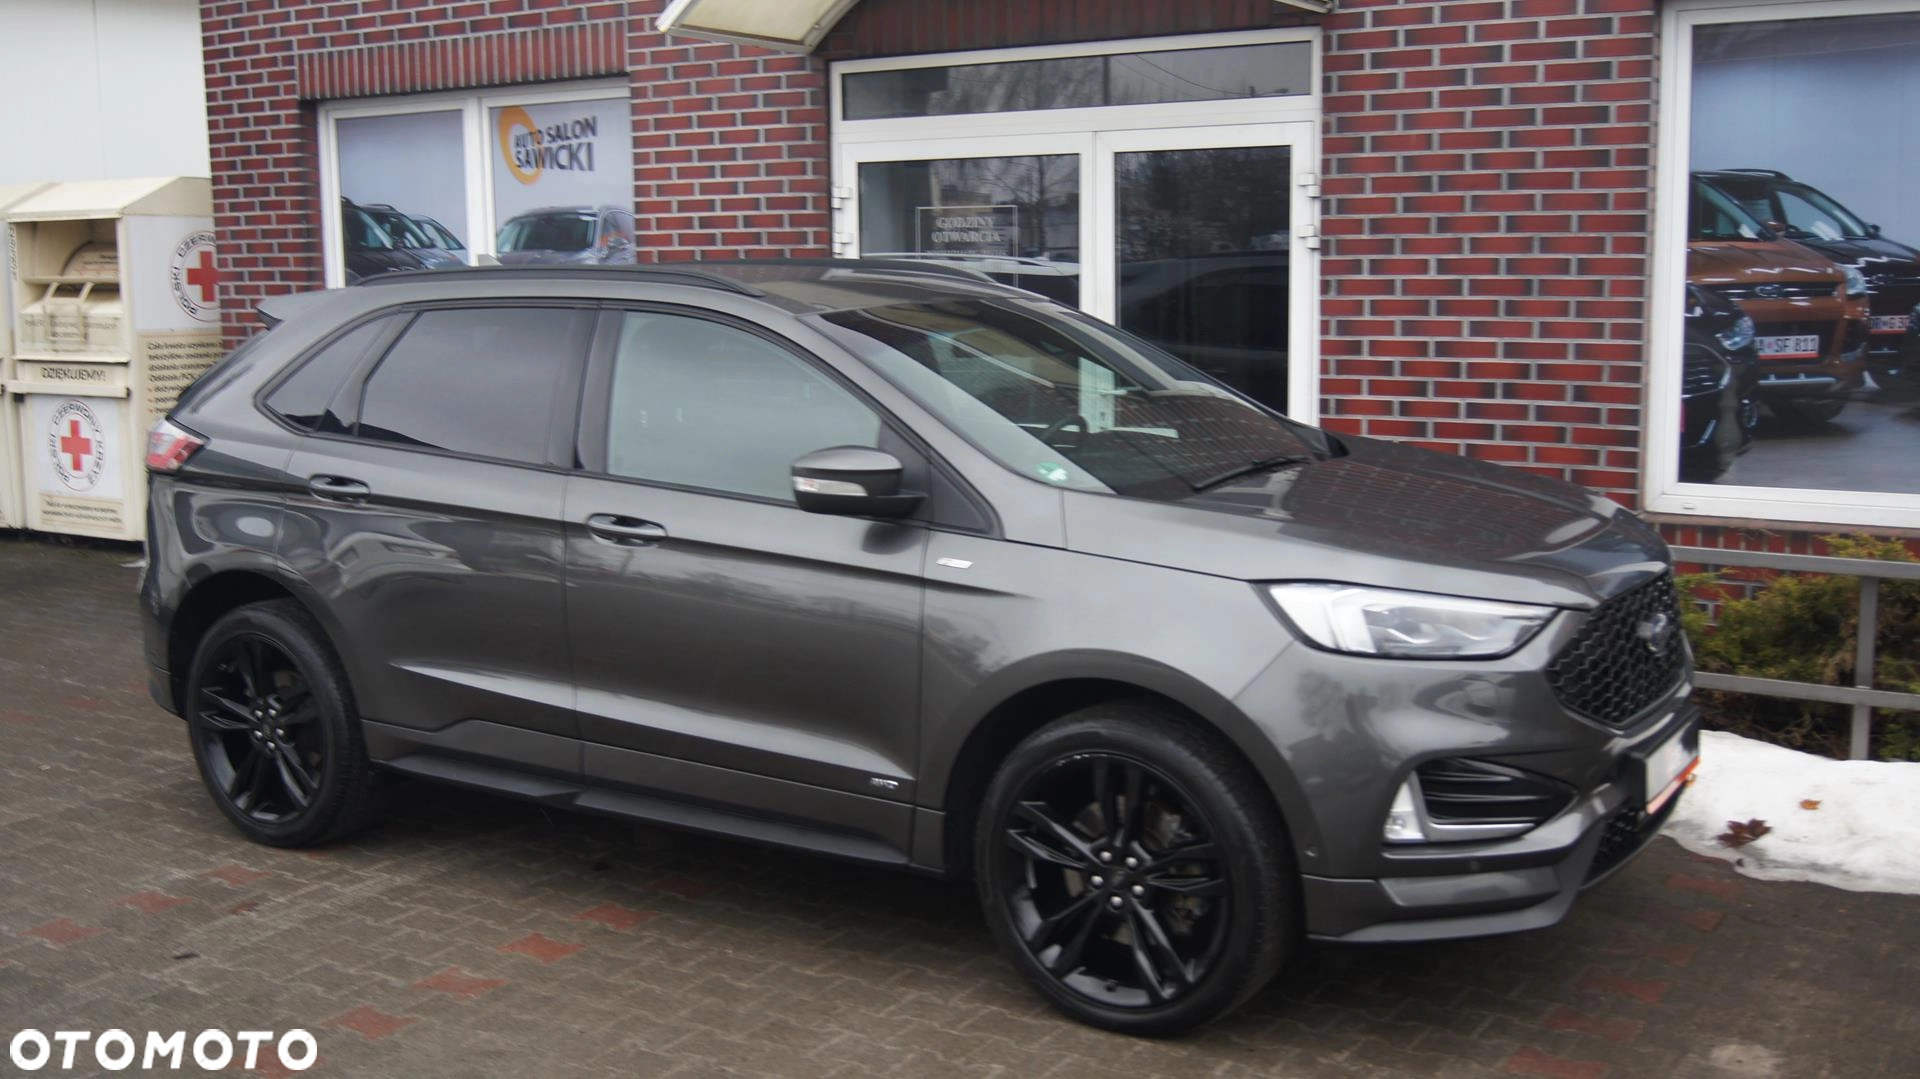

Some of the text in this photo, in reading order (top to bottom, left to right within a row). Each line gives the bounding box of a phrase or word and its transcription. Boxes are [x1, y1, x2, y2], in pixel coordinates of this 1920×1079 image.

[514, 115, 598, 148] AUTO SALON
[515, 142, 595, 172] SAWICKI
